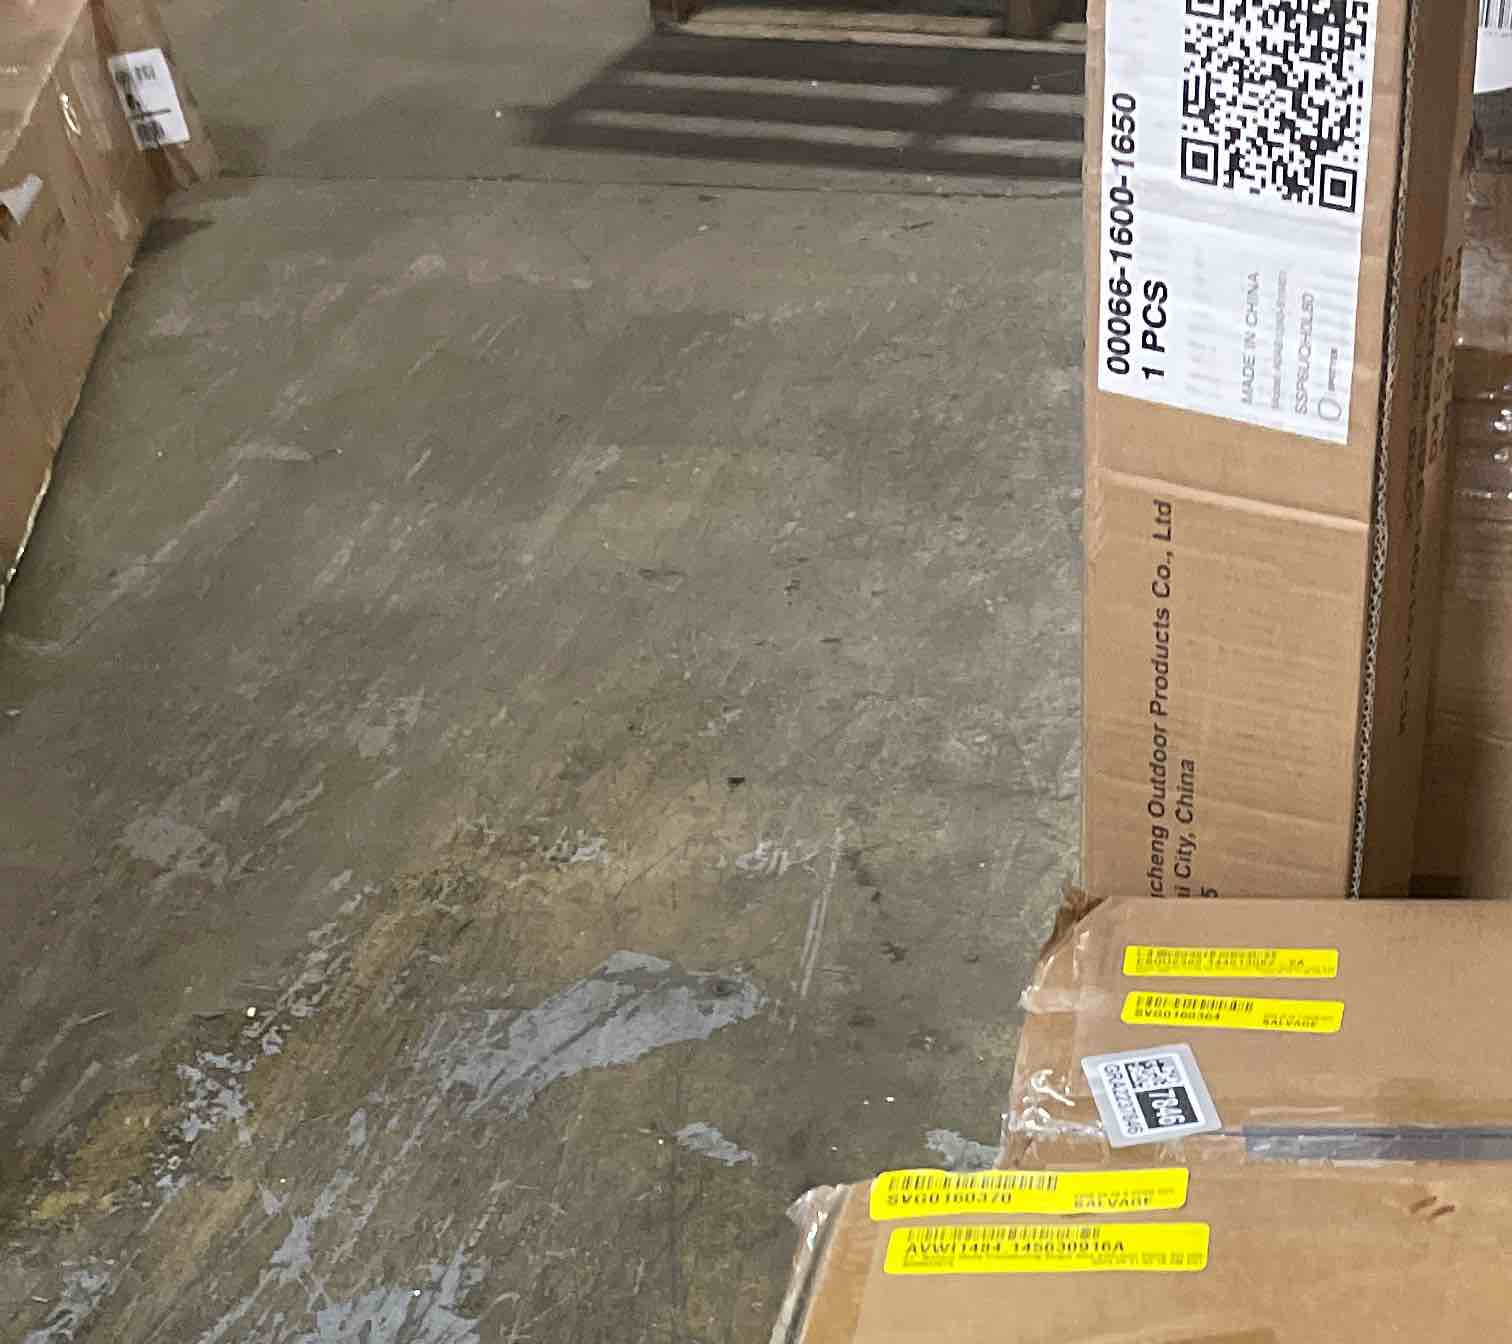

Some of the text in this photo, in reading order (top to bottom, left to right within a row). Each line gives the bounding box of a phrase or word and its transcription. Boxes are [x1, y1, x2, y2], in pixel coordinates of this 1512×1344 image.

[1106, 93, 1138, 376] 00066-1600-1650
[1142, 280, 1169, 381] 1 PCS
[1241, 272, 1260, 405] MADE IN CHINA
[1153, 499, 1173, 542] Ltd
[1151, 551, 1174, 598] Co.,
[1150, 607, 1171, 717] Products
[1148, 723, 1169, 818] Outdoor
[1175, 759, 1196, 824] China
[1174, 833, 1197, 879] City,
[1149, 1088, 1186, 1125] 7846
